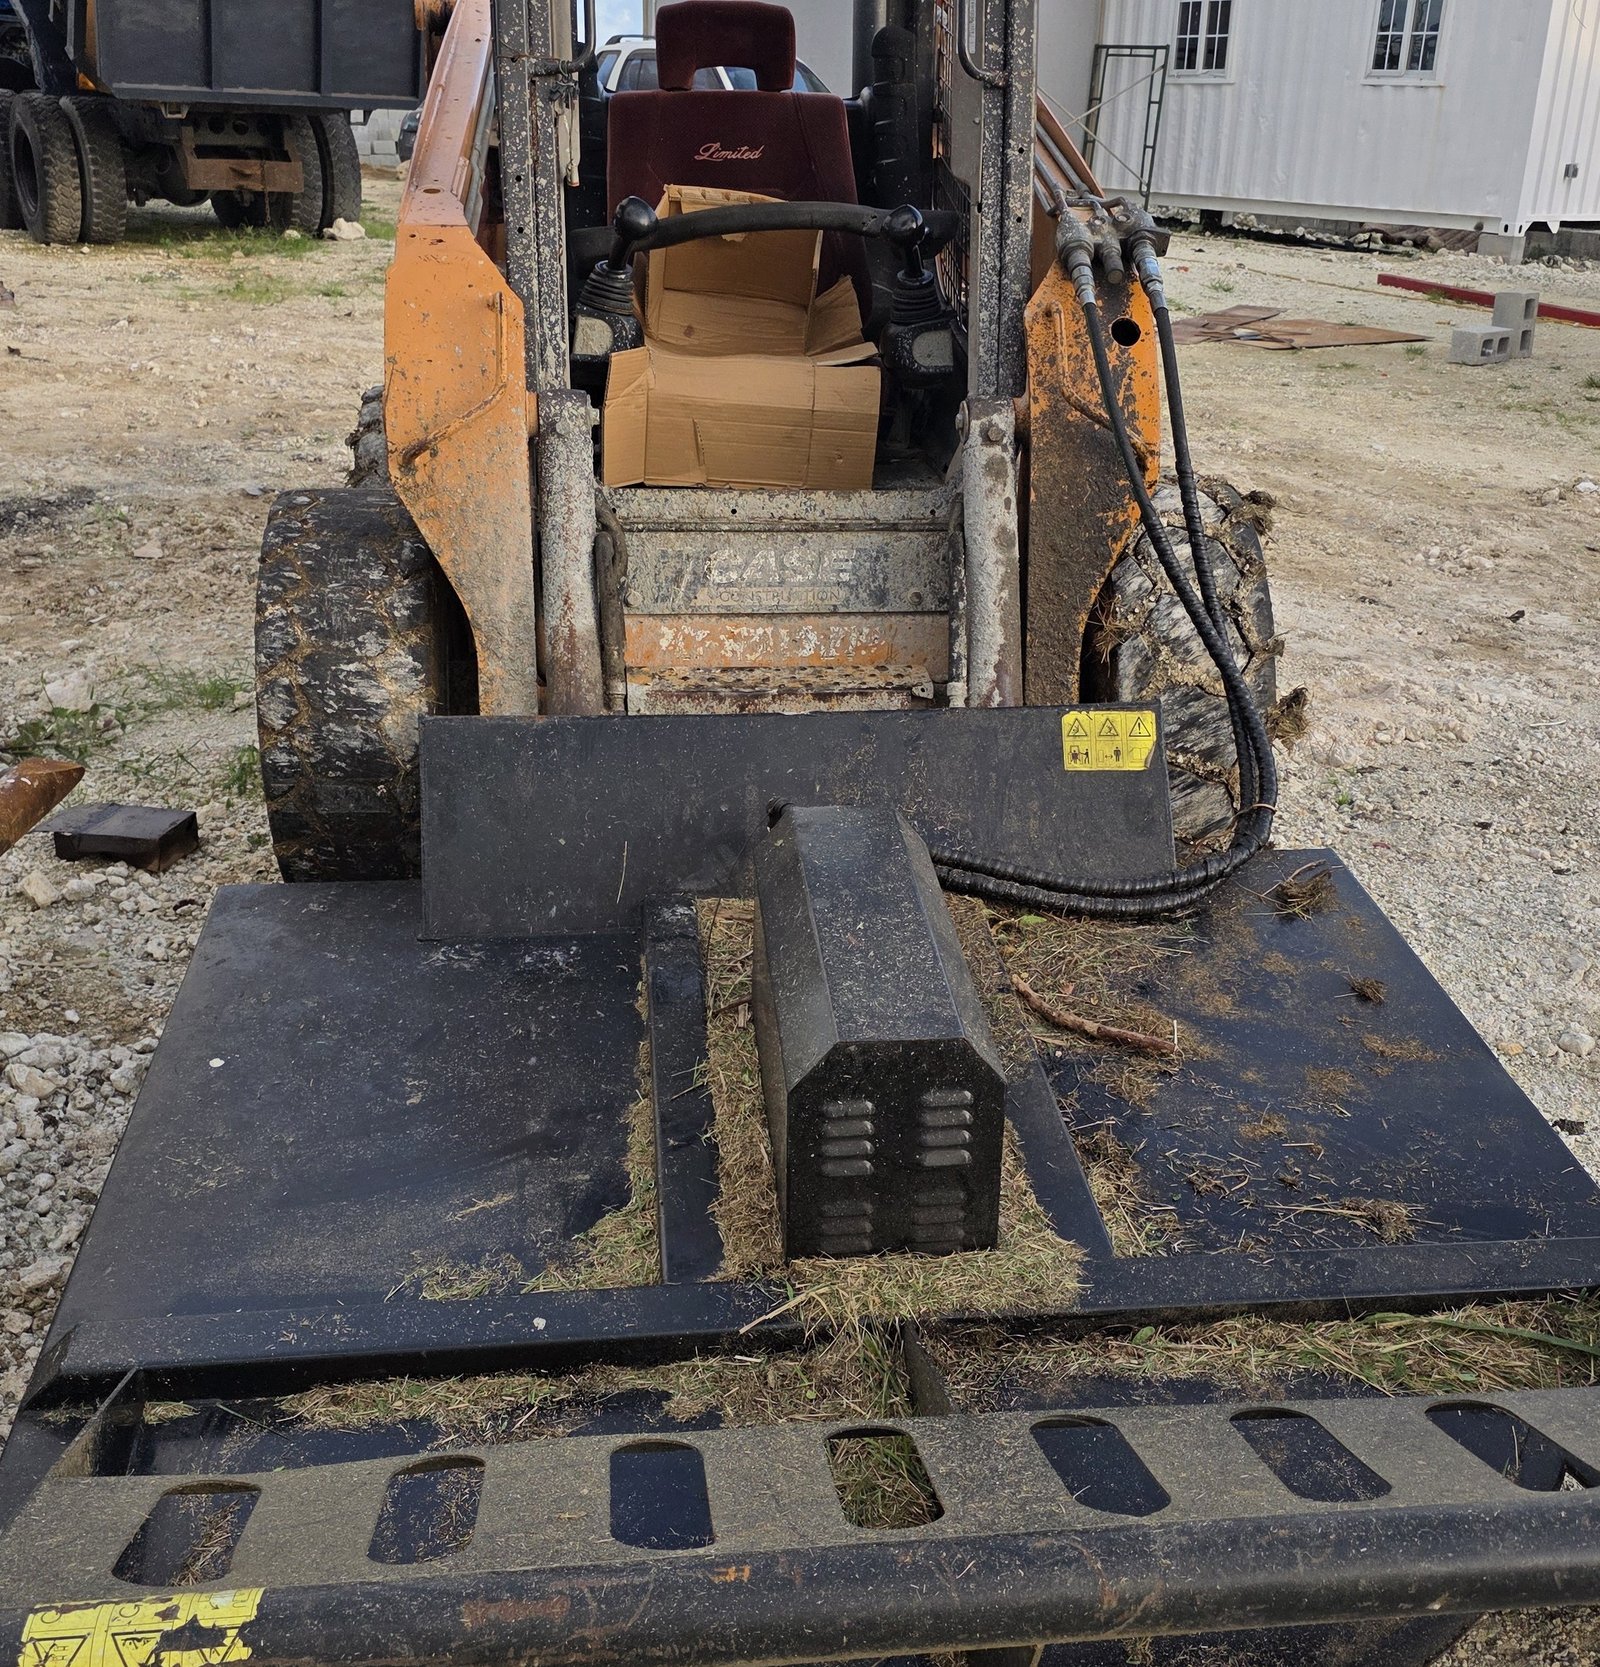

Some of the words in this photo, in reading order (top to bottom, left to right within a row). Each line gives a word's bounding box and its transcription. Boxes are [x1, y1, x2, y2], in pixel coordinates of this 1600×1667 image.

[694, 142, 765, 161] Limited
[704, 547, 855, 584] CASE
[719, 589, 841, 602] CONSTRUTION
